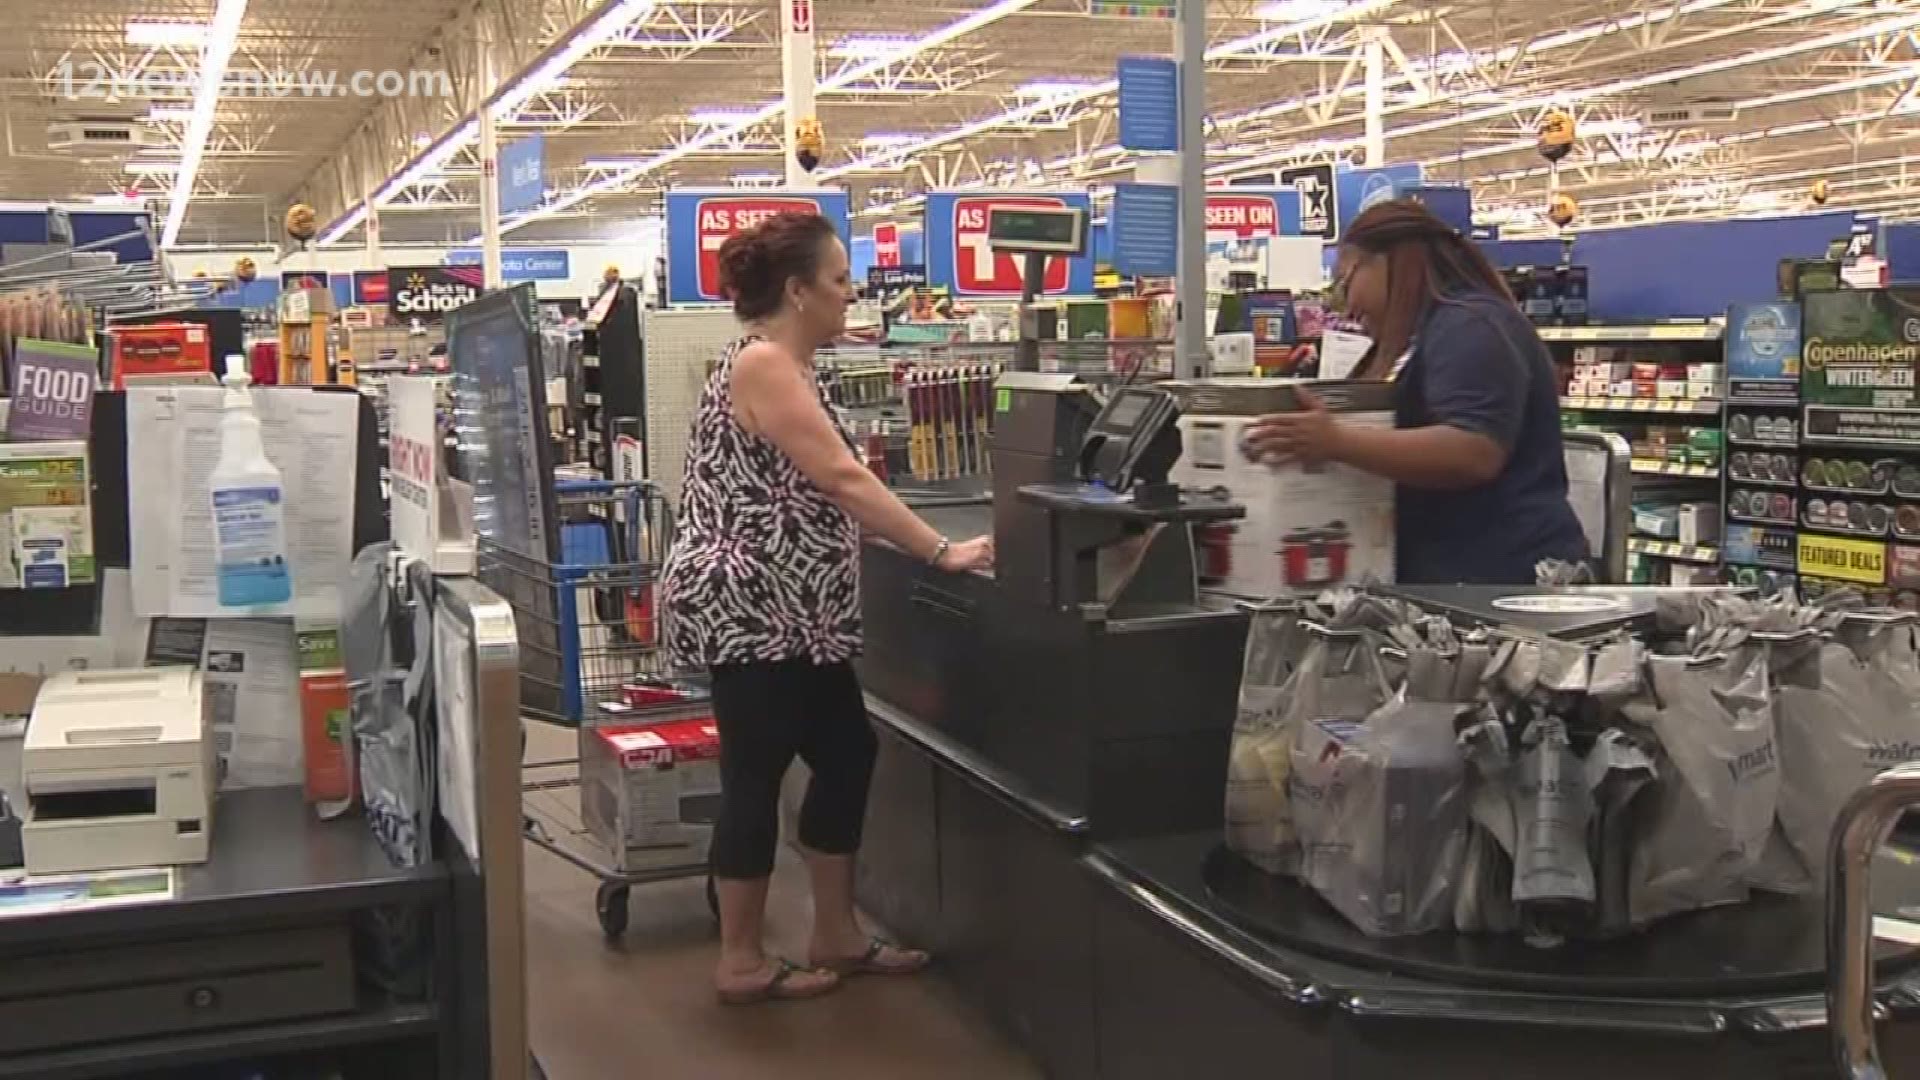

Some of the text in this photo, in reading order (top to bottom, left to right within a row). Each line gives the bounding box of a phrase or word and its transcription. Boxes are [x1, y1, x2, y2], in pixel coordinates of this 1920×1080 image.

[702, 210, 777, 230] AS SEE
[958, 209, 985, 228] AS
[1205, 206, 1273, 225] SEEN ON
[397, 288, 475, 312] School
[1803, 337, 1916, 371] Copenhagen
[18, 365, 89, 402] FOOD
[16, 398, 86, 419] GUIDE
